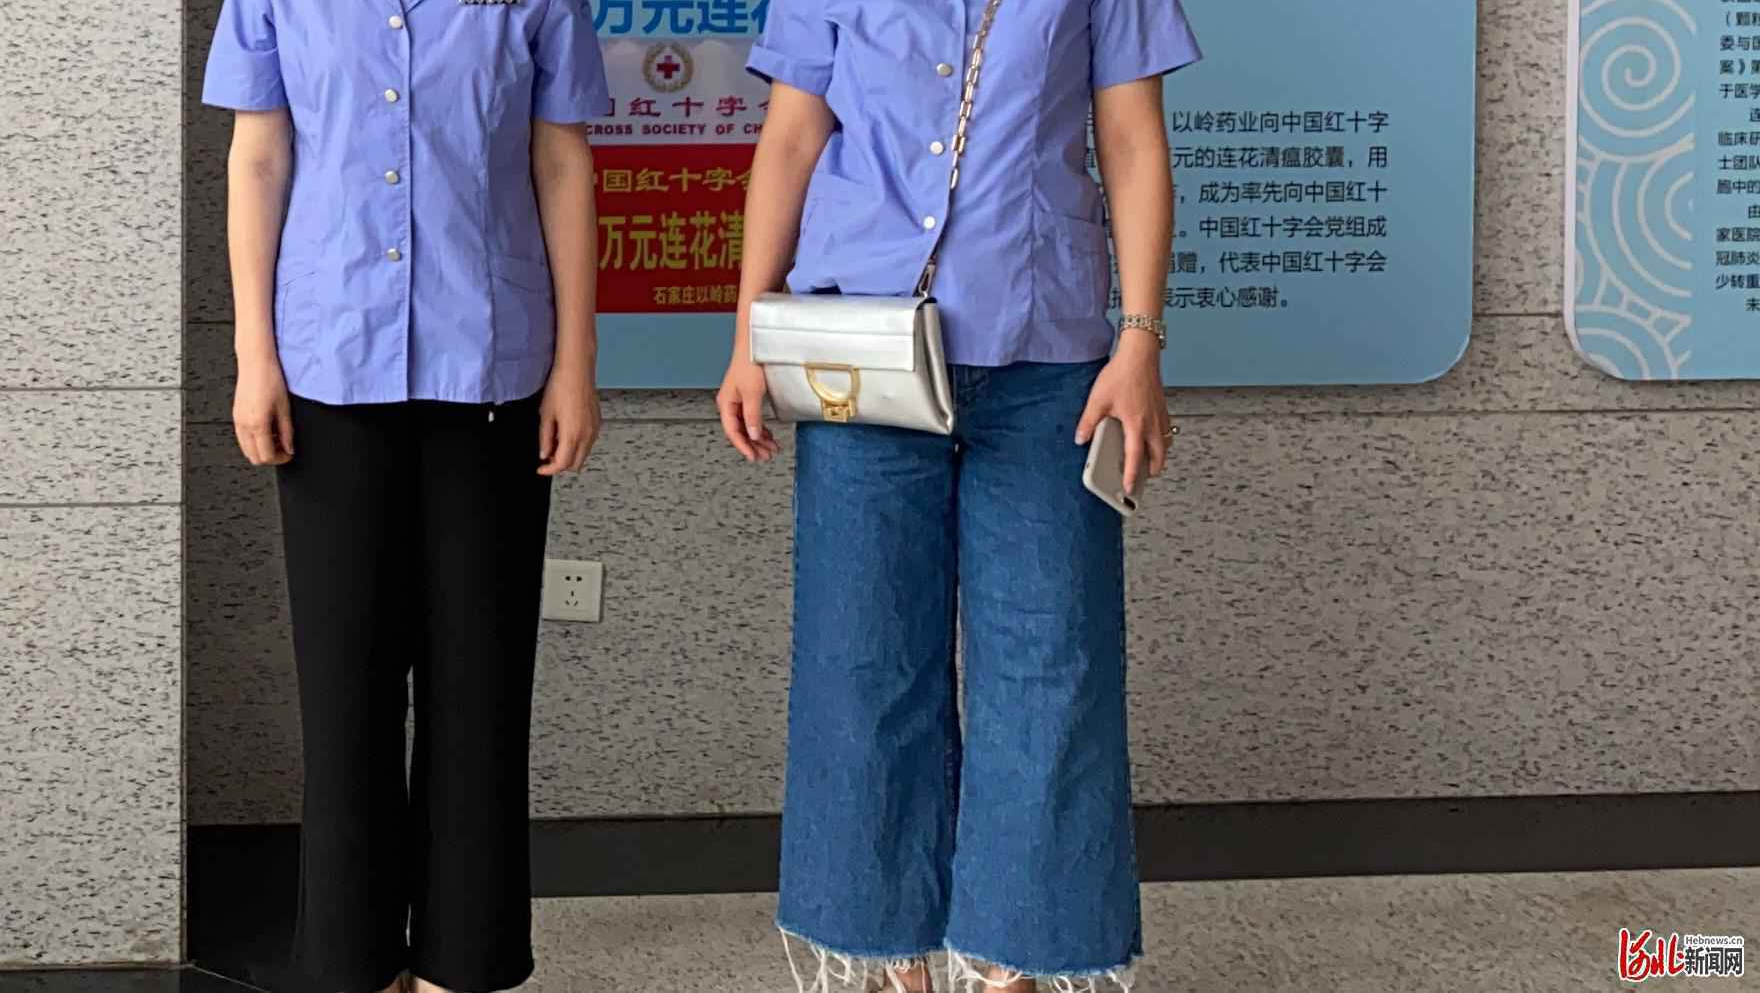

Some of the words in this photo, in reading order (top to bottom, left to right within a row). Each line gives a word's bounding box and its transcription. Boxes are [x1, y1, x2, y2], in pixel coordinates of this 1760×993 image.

[642, 124, 707, 136] SOCIETY
[715, 124, 736, 136] OF
[1172, 111, 1389, 134] 以岭药业向中国红十字
[593, 166, 752, 194] 国红十字
[1172, 181, 1387, 204] ，成为率先向中国红十
[1172, 216, 1388, 239] 。中国红十字会党组成
